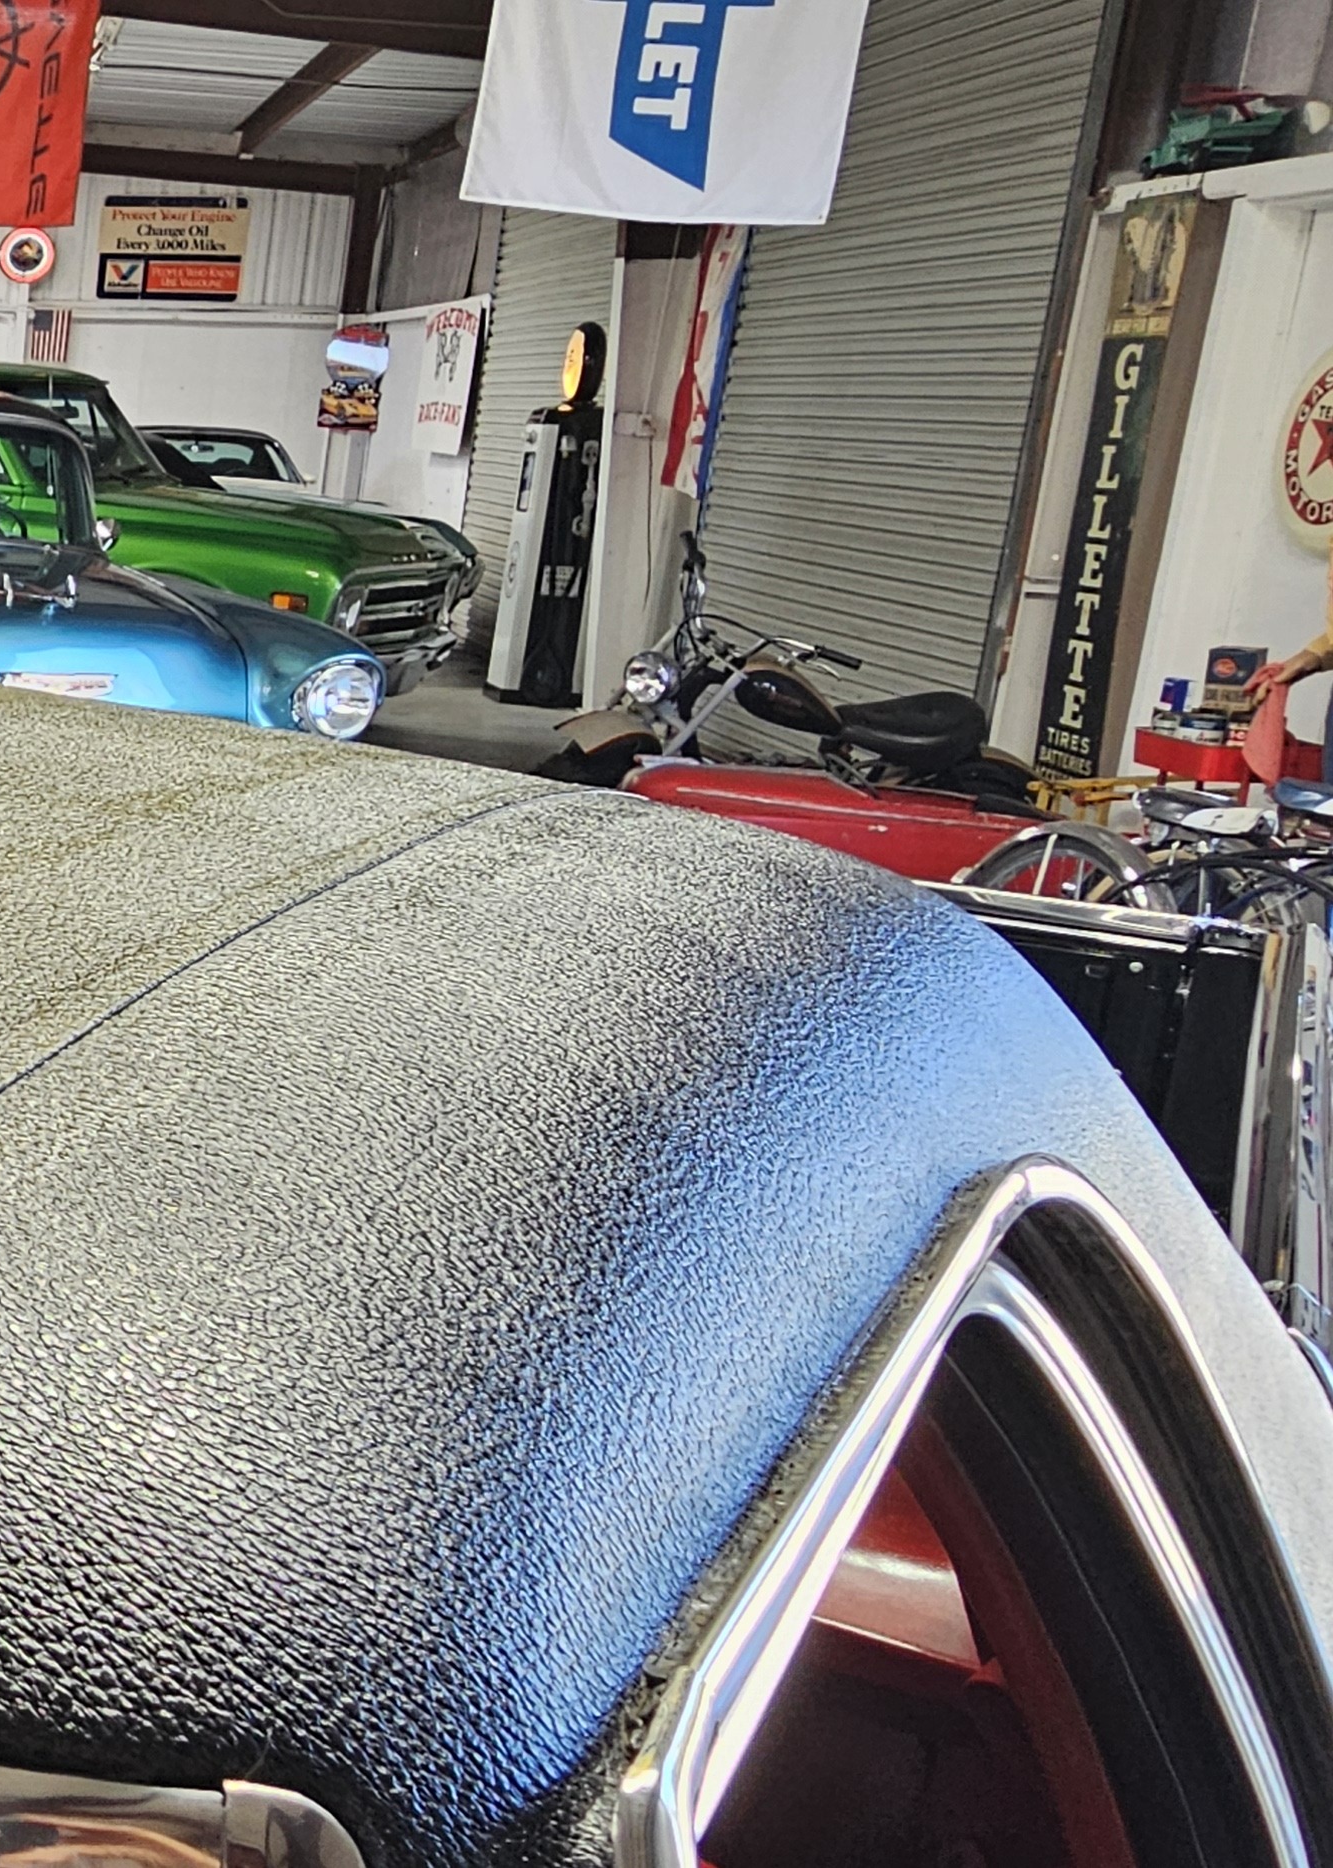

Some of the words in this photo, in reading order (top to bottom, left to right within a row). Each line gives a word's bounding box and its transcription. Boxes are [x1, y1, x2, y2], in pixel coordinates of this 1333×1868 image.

[633, 2, 706, 130] LET
[112, 209, 157, 222] Protect
[160, 210, 187, 222] Your
[191, 210, 236, 223] Engine
[137, 224, 186, 238] Change
[188, 225, 209, 237] Oil
[116, 238, 150, 252] Every
[191, 239, 226, 251] Miles
[425, 307, 478, 342] WELCOME
[1059, 344, 1144, 728] GILLETTE
[1047, 726, 1091, 755] TIRES
[1039, 744, 1093, 777] BATTERIES
